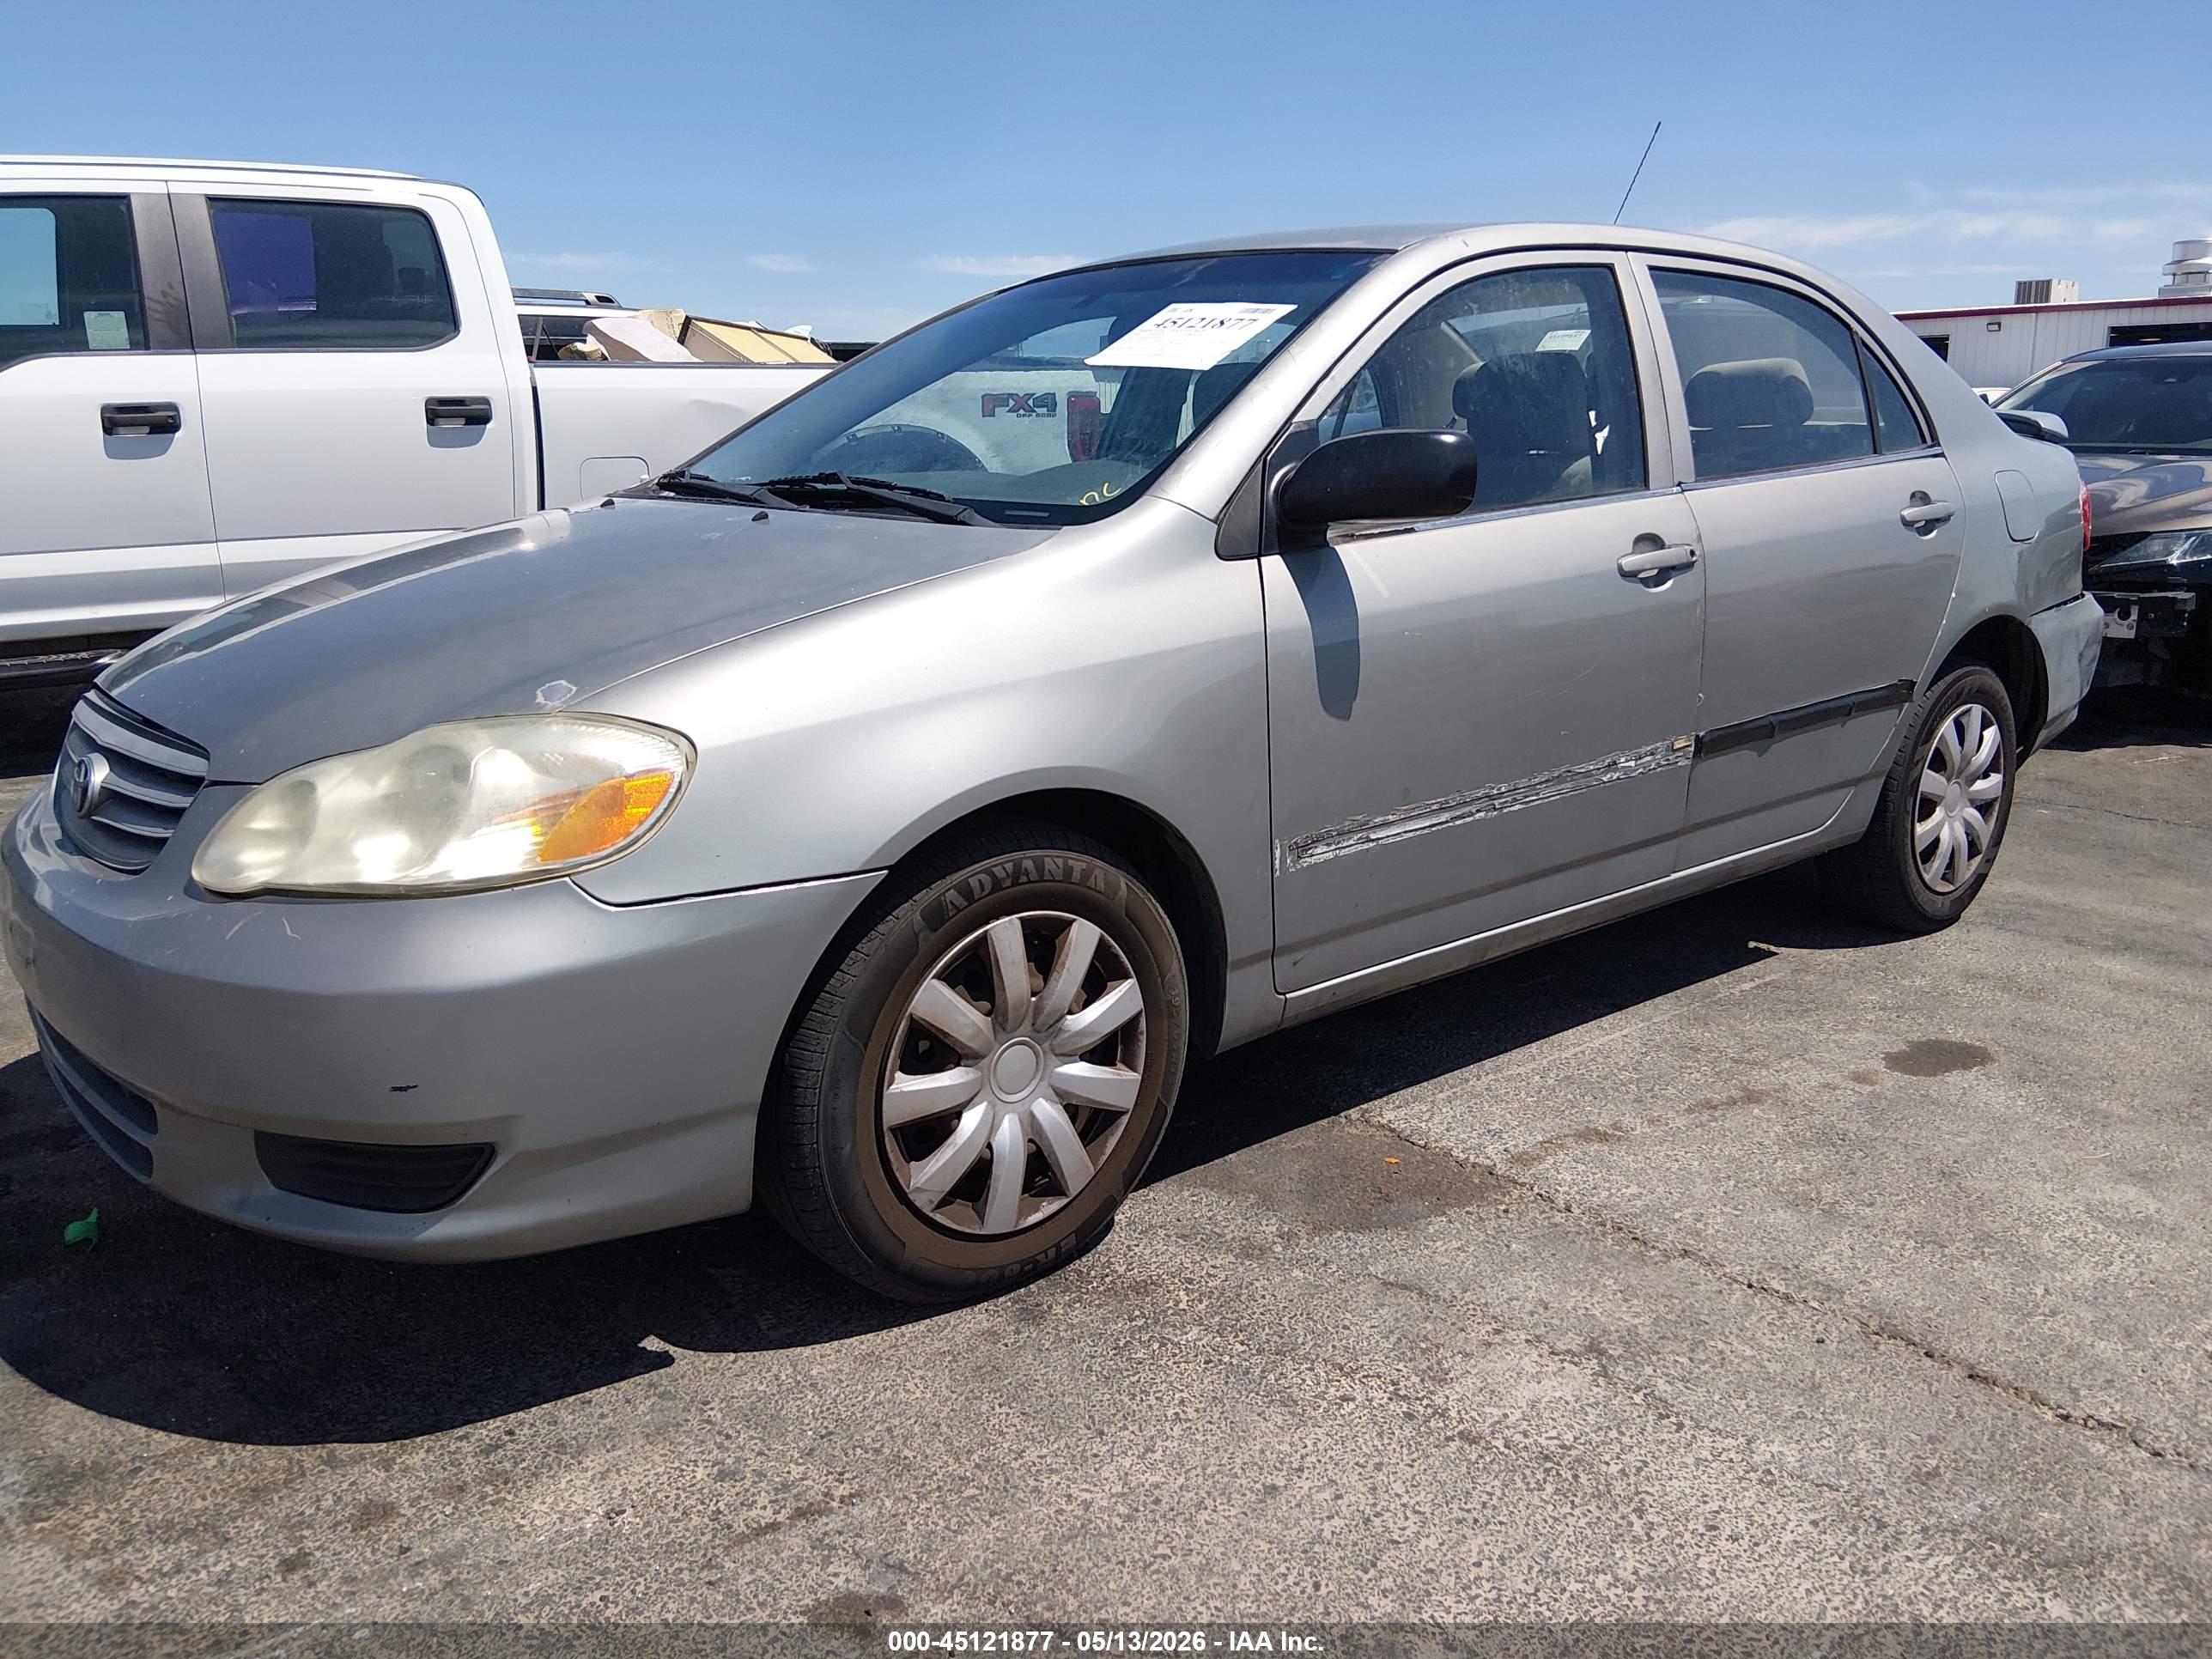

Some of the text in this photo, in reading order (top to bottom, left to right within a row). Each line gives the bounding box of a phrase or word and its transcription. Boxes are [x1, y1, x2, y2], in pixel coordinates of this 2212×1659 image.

[1153, 317, 1260, 330] 45121877
[981, 392, 1057, 417] FX4
[943, 857, 1106, 918] ADVANTA
